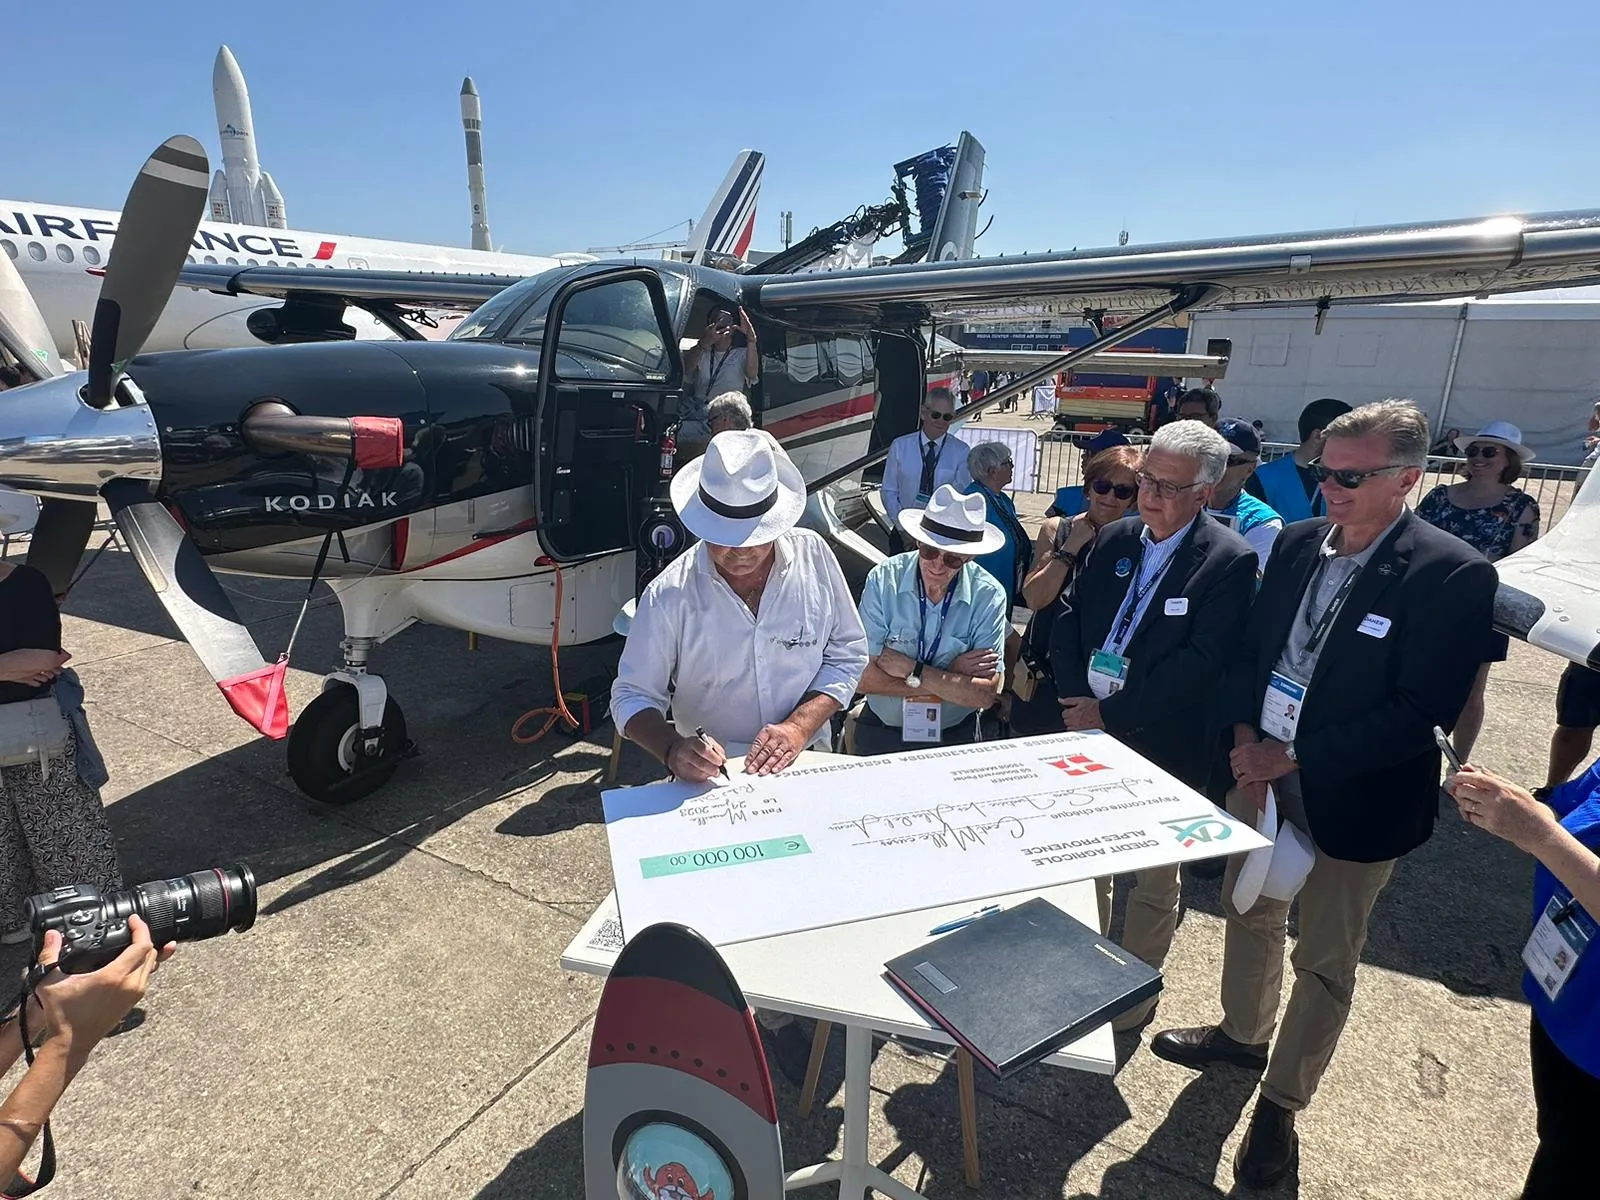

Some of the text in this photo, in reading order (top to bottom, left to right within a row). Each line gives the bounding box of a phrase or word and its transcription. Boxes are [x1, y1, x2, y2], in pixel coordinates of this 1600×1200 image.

[264, 491, 398, 512] KODIAK
[1108, 800, 1146, 811] contre
[732, 843, 765, 861] 100
[1021, 829, 1147, 856] ALPES PROVENCE
[1031, 846, 1106, 867] AGRICOLE
